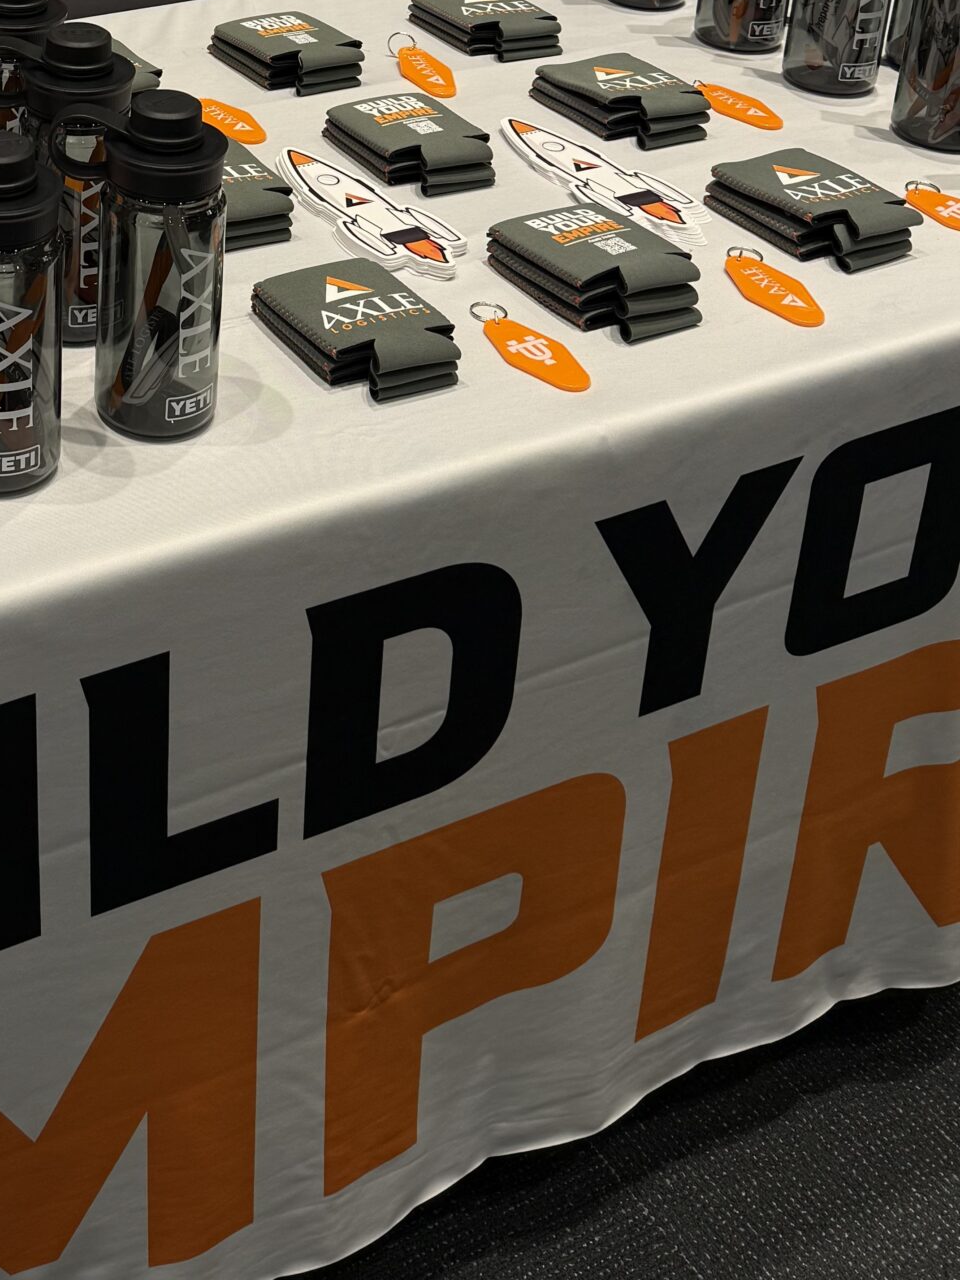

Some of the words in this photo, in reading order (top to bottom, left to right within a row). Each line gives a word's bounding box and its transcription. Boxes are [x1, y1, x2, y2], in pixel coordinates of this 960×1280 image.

[596, 72, 677, 89] AXLE
[353, 95, 417, 113] BUILD
[361, 101, 431, 117] YOUR
[374, 107, 439, 125] EMPIRE
[783, 173, 872, 200] AXLE
[523, 208, 596, 230] BUILD
[538, 214, 614, 235] YOUR
[551, 218, 625, 244] EMPIRE
[178, 248, 214, 378] AXLE
[321, 292, 424, 329] AXLE
[330, 306, 431, 334] LOGISTICS
[170, 388, 212, 417] YETI
